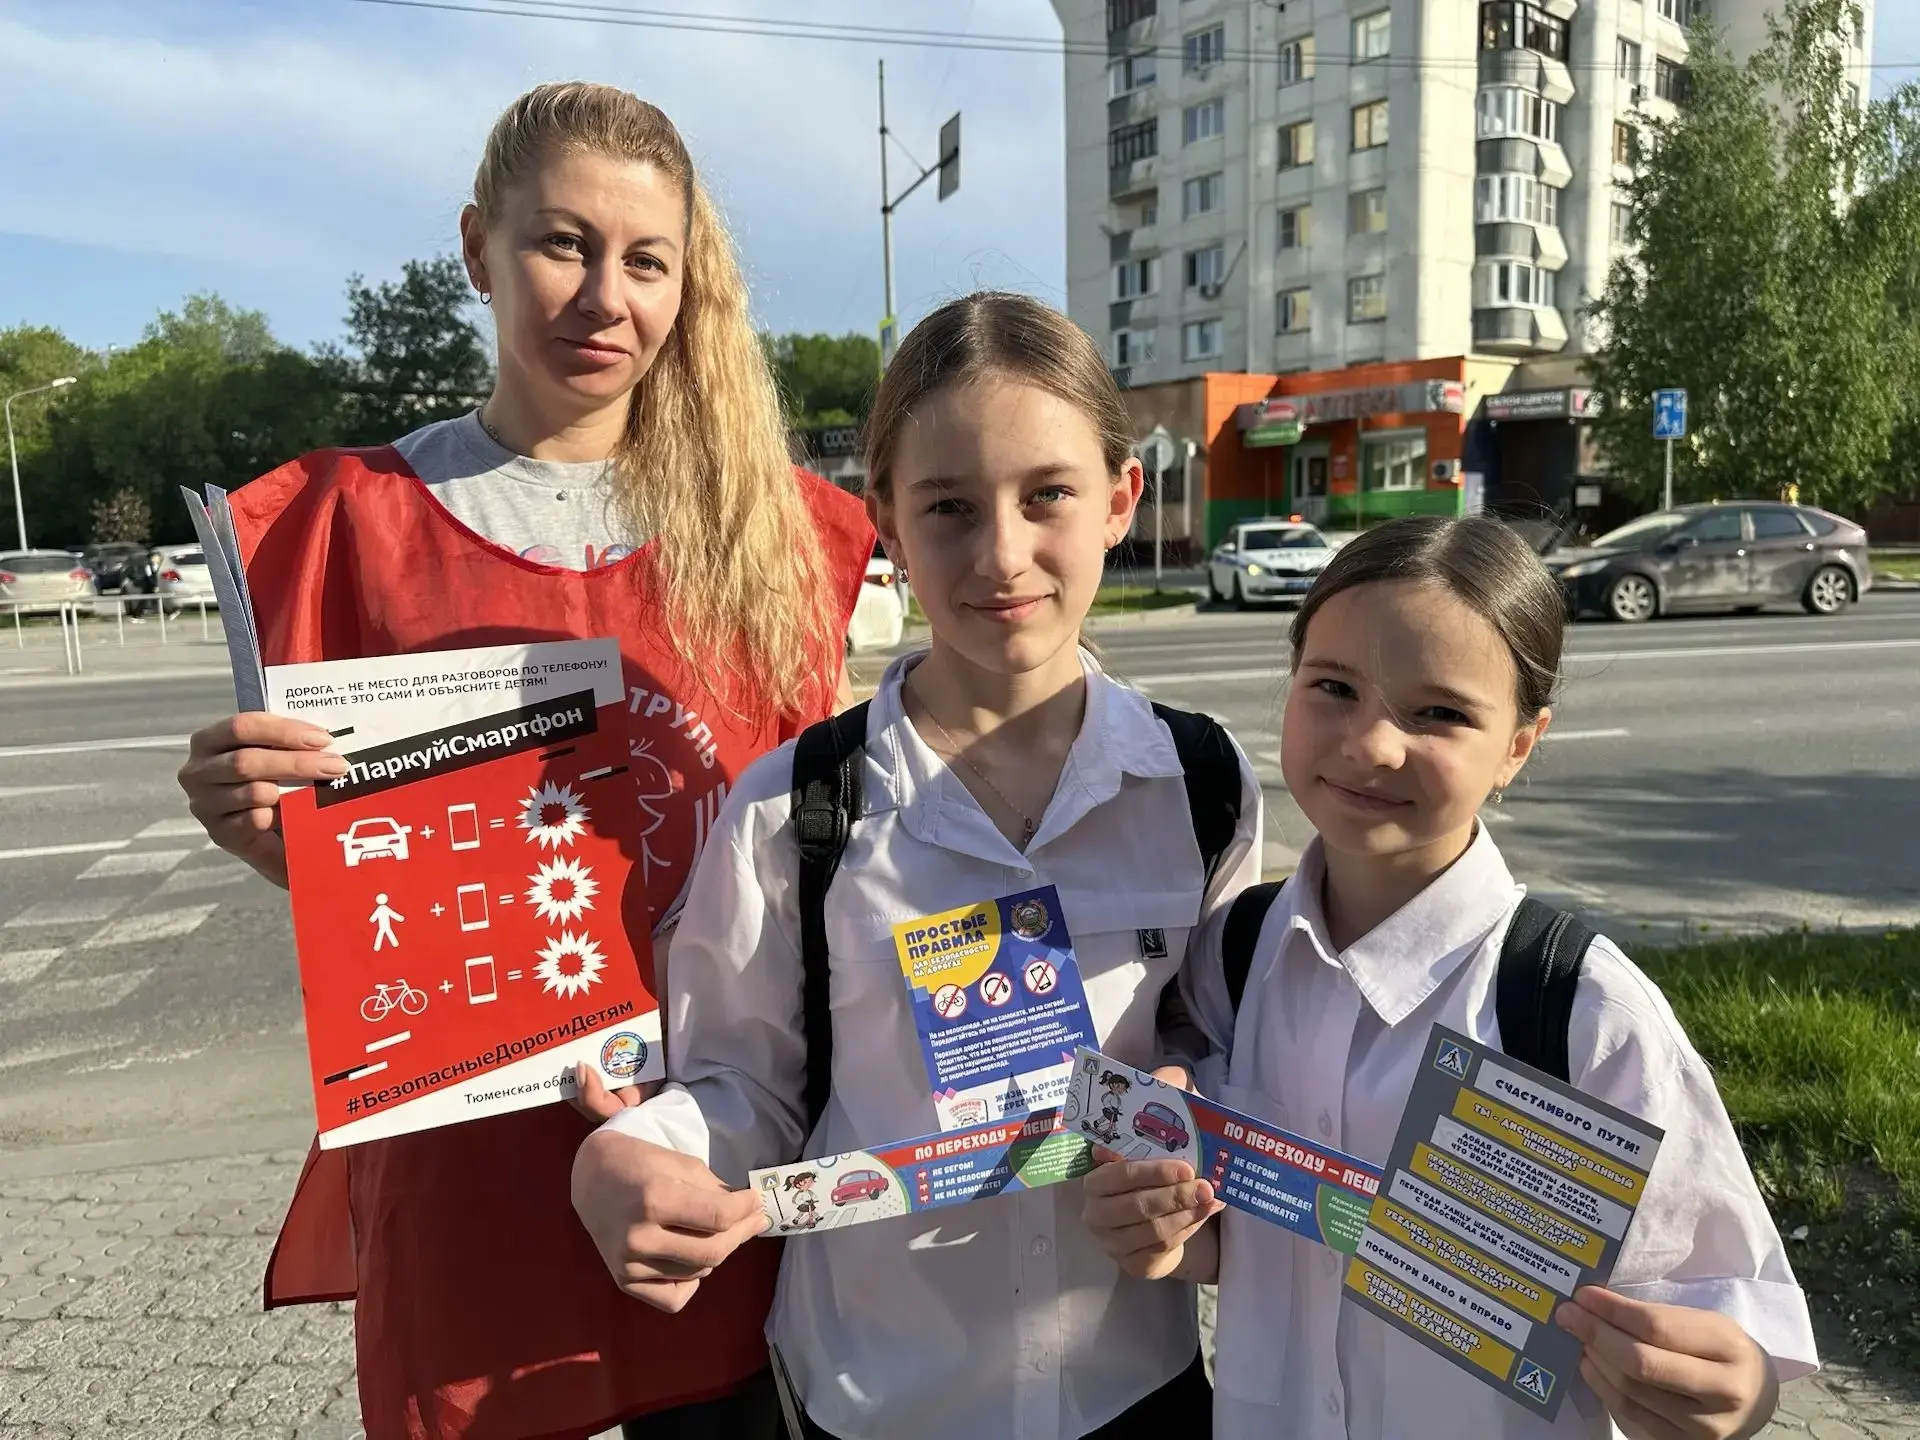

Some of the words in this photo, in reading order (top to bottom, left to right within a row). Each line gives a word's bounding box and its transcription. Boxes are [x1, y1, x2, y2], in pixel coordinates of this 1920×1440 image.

[285, 685, 332, 698] ДОРОГА
[348, 682, 364, 691] НЕ
[368, 677, 408, 689] МЕСТО
[411, 675, 437, 686] ДЛЯ
[442, 667, 517, 682] РАЗГОВОРОВ
[521, 665, 539, 675] ПО
[543, 660, 607, 673] ТЕЛЕФОНУ!
[287, 697, 346, 710] ПОМНИТЕ
[350, 693, 373, 704] ЭТО
[377, 689, 412, 701] САМИ
[416, 688, 425, 697] И
[428, 681, 500, 695] ОБЪЯСНИТЕ
[504, 677, 547, 690] ДЕТЯМ!
[328, 706, 583, 790] #ПаркуйСмартфон
[905, 913, 987, 944] ПРОСТЫЕ
[908, 929, 984, 959] ПРАВИЛА
[912, 959, 928, 969] ДЛЯ
[931, 944, 989, 964] БЕЗОПАСНОСТИ
[913, 968, 924, 977] НА
[926, 959, 961, 974] ДОРОГАХ
[343, 1001, 633, 1115] #БезопасныеДорогиДетям
[464, 1082, 539, 1104] Тюменская
[543, 1074, 575, 1088] обла
[995, 1088, 1027, 1101] ЖИЗНЬ
[1030, 1076, 1070, 1093] ДОРОЖЕ
[997, 1094, 1043, 1112] БЕРЕГИТЕ
[914, 1145, 932, 1160] ПО
[935, 1128, 1006, 1155] ПЕРЕХОДУ
[1022, 1116, 1064, 1136] ПЕШК
[1494, 1078, 1592, 1131] СЧАСТЛИВОГО
[1596, 1127, 1640, 1154] ПУТИ!
[931, 1167, 942, 1176] НЕ
[944, 1161, 973, 1173] БЕГОМ!
[1223, 1121, 1244, 1141] ПО
[1245, 1130, 1325, 1172] ПЕРЕХОДУ
[1233, 1156, 1245, 1167] НЕ
[1246, 1162, 1278, 1180] БЕГОМ!
[1462, 1132, 1491, 1150] ДОЙДЯ
[1493, 1148, 1506, 1158] ДО
[1509, 1156, 1557, 1184] СЕРЕДИНЫ
[1559, 1182, 1599, 1206] ДОРОГИ,
[1475, 1105, 1490, 1118] ТЫ
[1500, 1117, 1634, 1188] ДИСЦИПЛИНИРОВАННЫЙ
[1522, 1138, 1577, 1171] ПЕШЕХОД!
[933, 1179, 943, 1188] НЕ
[944, 1177, 955, 1186] НА
[956, 1166, 1008, 1183] ВЕЛОСИПЕДЕ!
[934, 1191, 944, 1200] НЕ
[946, 1189, 956, 1197] НА
[957, 1180, 1000, 1195] САМОКАТЕ!
[1229, 1171, 1241, 1182] НЕ
[1241, 1176, 1254, 1187] НА
[1254, 1181, 1312, 1211] ВЕЛОСИПЕДЕ!
[1427, 1154, 1462, 1175] ПРОЙДЯ
[1462, 1172, 1497, 1194] ПЕРВУЮ
[1498, 1191, 1534, 1214] ПОЛОСУ
[1536, 1211, 1590, 1243] ДВИЖЕНИЯ,
[1450, 1142, 1467, 1155] ЧТО
[1469, 1153, 1514, 1179] ВОДИТЕЛИ
[1516, 1177, 1539, 1192] ТЕБЯ
[1542, 1190, 1602, 1224] ПРОПУСКАЮТ
[1457, 1138, 1502, 1164] ПОСМОТРИ
[1504, 1162, 1543, 1185] НАПРАВО
[1545, 1183, 1553, 1191] И
[1555, 1189, 1600, 1215] УБЕДИСЬ,
[1225, 1185, 1237, 1197] НЕ
[1237, 1190, 1250, 1202] НА
[1250, 1196, 1299, 1222] САМОКАТЕ!
[1399, 1179, 1441, 1205] ПЕРЕХОДИ
[1442, 1203, 1471, 1222] УЛИЦУ
[1473, 1220, 1506, 1242] ШАГОМ,
[1508, 1240, 1571, 1276] СПЕШИВШИСЬ
[1427, 1161, 1468, 1187] УБЕДИСЬ,
[1470, 1184, 1487, 1197] ЧТО
[1490, 1194, 1537, 1224] ВОДИТЕЛИ
[1546, 1225, 1584, 1248] ДРУГИХ
[1440, 1176, 1478, 1200] ПОЛОСАХ
[1480, 1197, 1502, 1213] ТЕБЯ
[1504, 1210, 1563, 1246] ПРОПУСКАЮТ
[1384, 1208, 1433, 1241] УБЕДИСЬ,
[1434, 1237, 1456, 1254] ЧТО
[1458, 1250, 1479, 1267] ВСЕ
[1480, 1263, 1540, 1300] ВОДИТЕЛИ
[1409, 1232, 1435, 1251] ТЕБЯ
[1436, 1247, 1506, 1292] ПРОПУСКАЮТ
[1423, 1200, 1477, 1234] ВЕЛОСИПЕДА
[1479, 1231, 1498, 1245] ИЛИ
[1500, 1243, 1548, 1273] САМОКАТА
[1362, 1270, 1407, 1302] СНИМИ
[1408, 1297, 1483, 1349] НАУШНИКИ,
[1365, 1240, 1419, 1276] ПОСМОТРИ
[1421, 1274, 1455, 1298] ВЛЕВО
[1457, 1295, 1467, 1305] И
[1470, 1302, 1512, 1330] ВПРАВО
[1366, 1285, 1408, 1315] УБЕРИ
[1410, 1311, 1471, 1353] ТЕЛЕФОН
